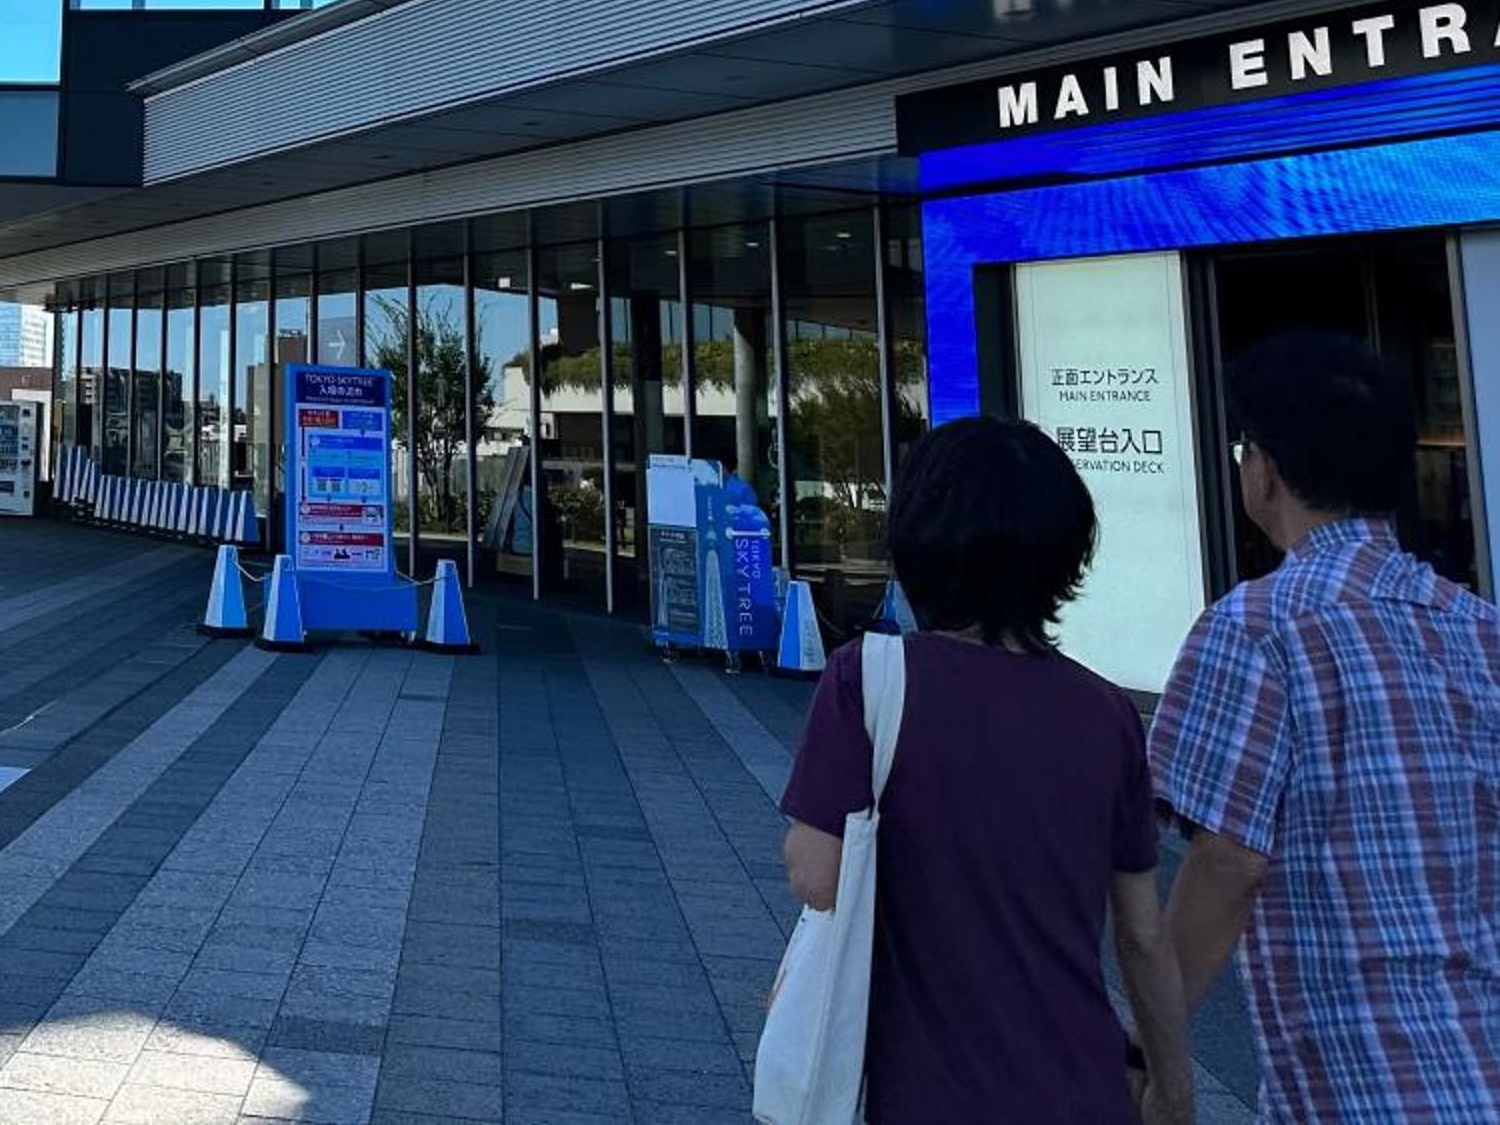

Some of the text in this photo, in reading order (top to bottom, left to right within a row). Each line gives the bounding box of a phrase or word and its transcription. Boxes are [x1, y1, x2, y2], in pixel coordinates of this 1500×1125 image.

[999, 2, 1500, 128] MAIN ENTR
[1051, 369, 1159, 386] 正面エントランス
[1059, 390, 1151, 402] MAIN ENTRANCE
[1056, 427, 1163, 455] 展望台入口
[1075, 459, 1165, 474] ERVATION DECK
[751, 539, 761, 579] TOKYO
